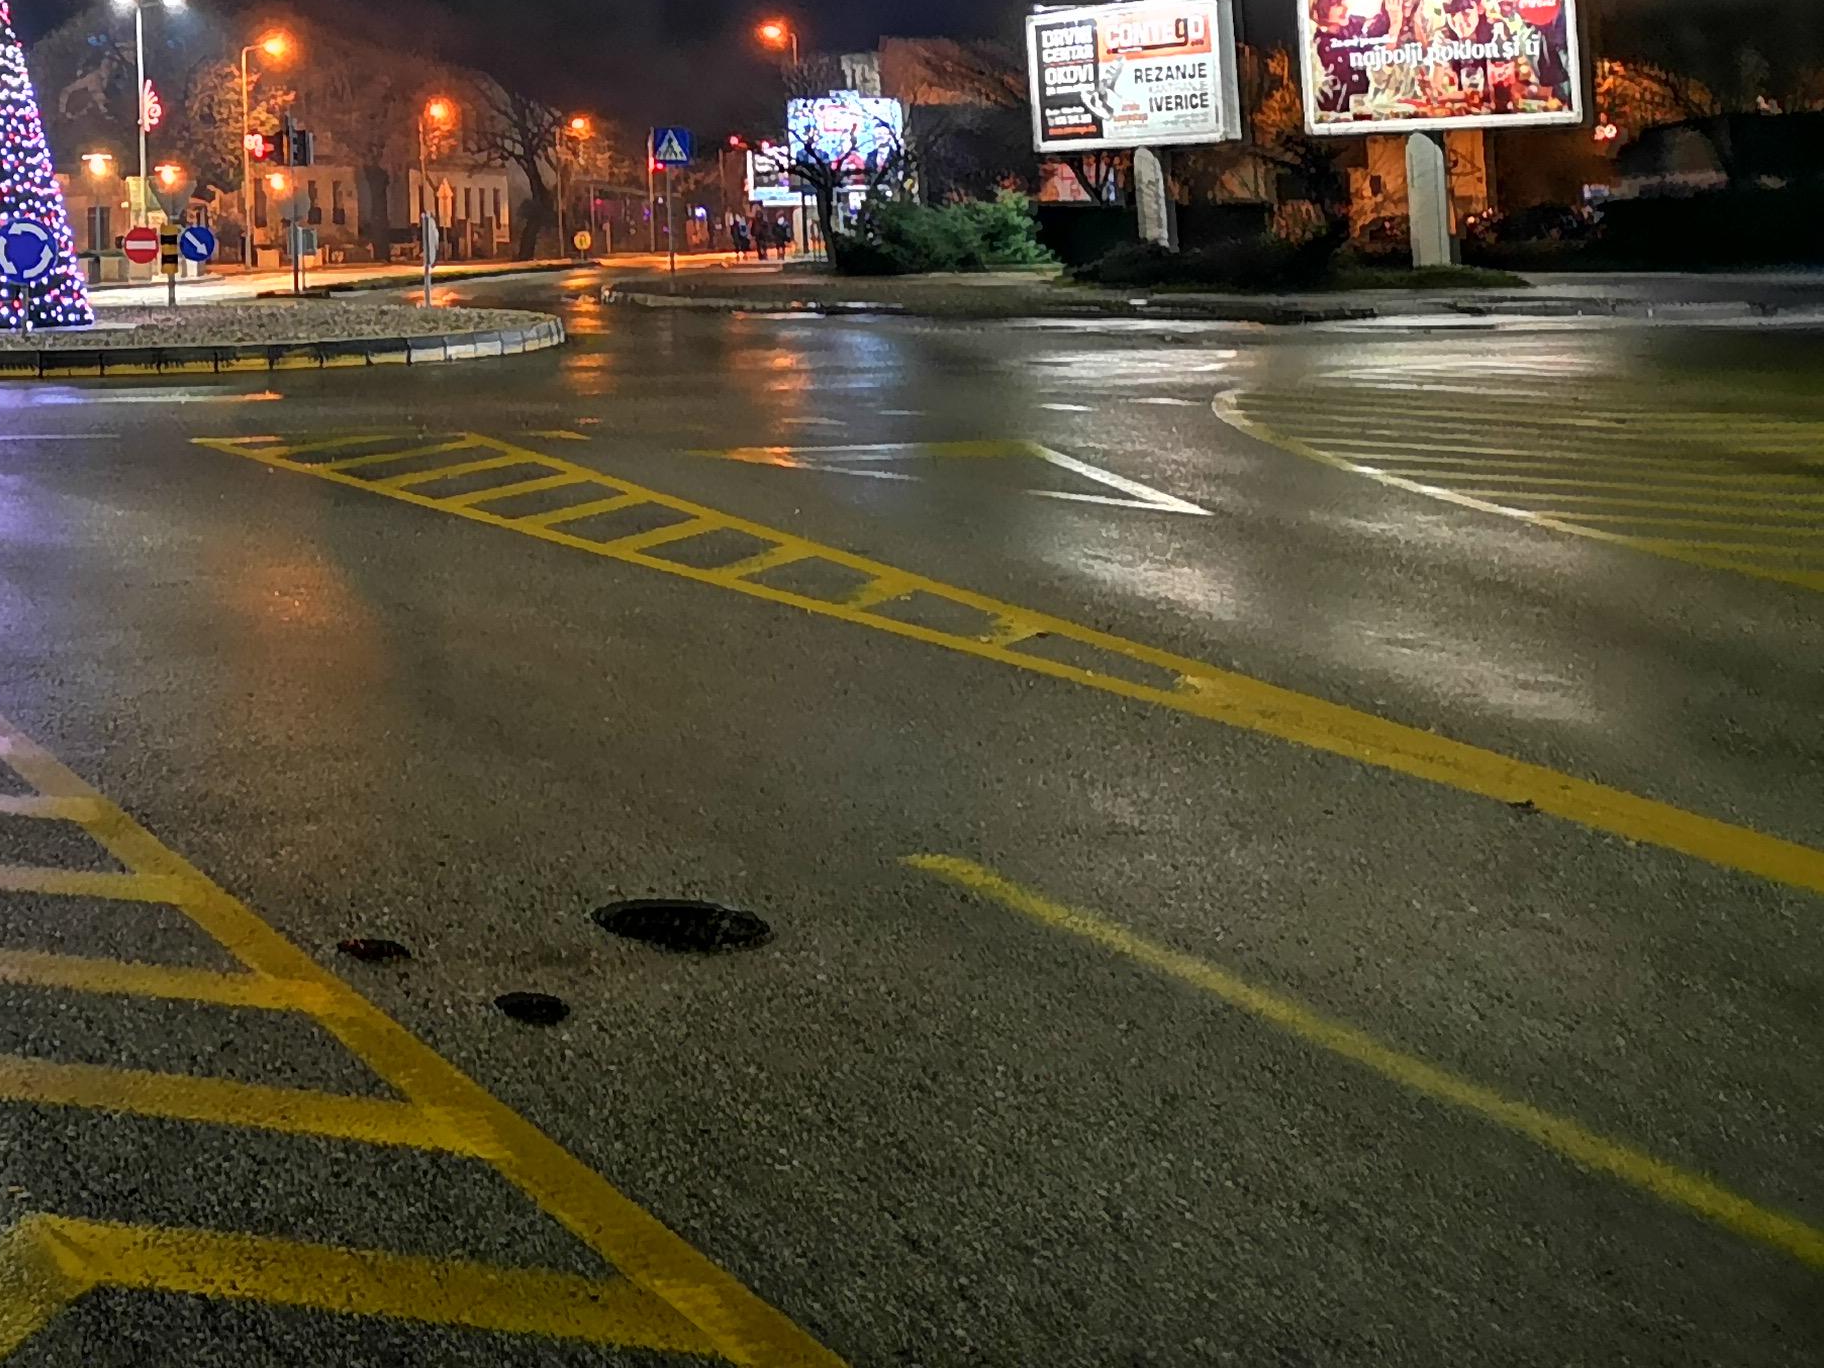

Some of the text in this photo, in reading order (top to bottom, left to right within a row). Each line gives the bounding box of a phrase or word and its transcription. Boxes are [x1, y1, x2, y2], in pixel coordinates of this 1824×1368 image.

[1044, 63, 1094, 85] OKOVI
[1134, 62, 1207, 84] REZANJE
[1148, 92, 1210, 113] IVERICE
